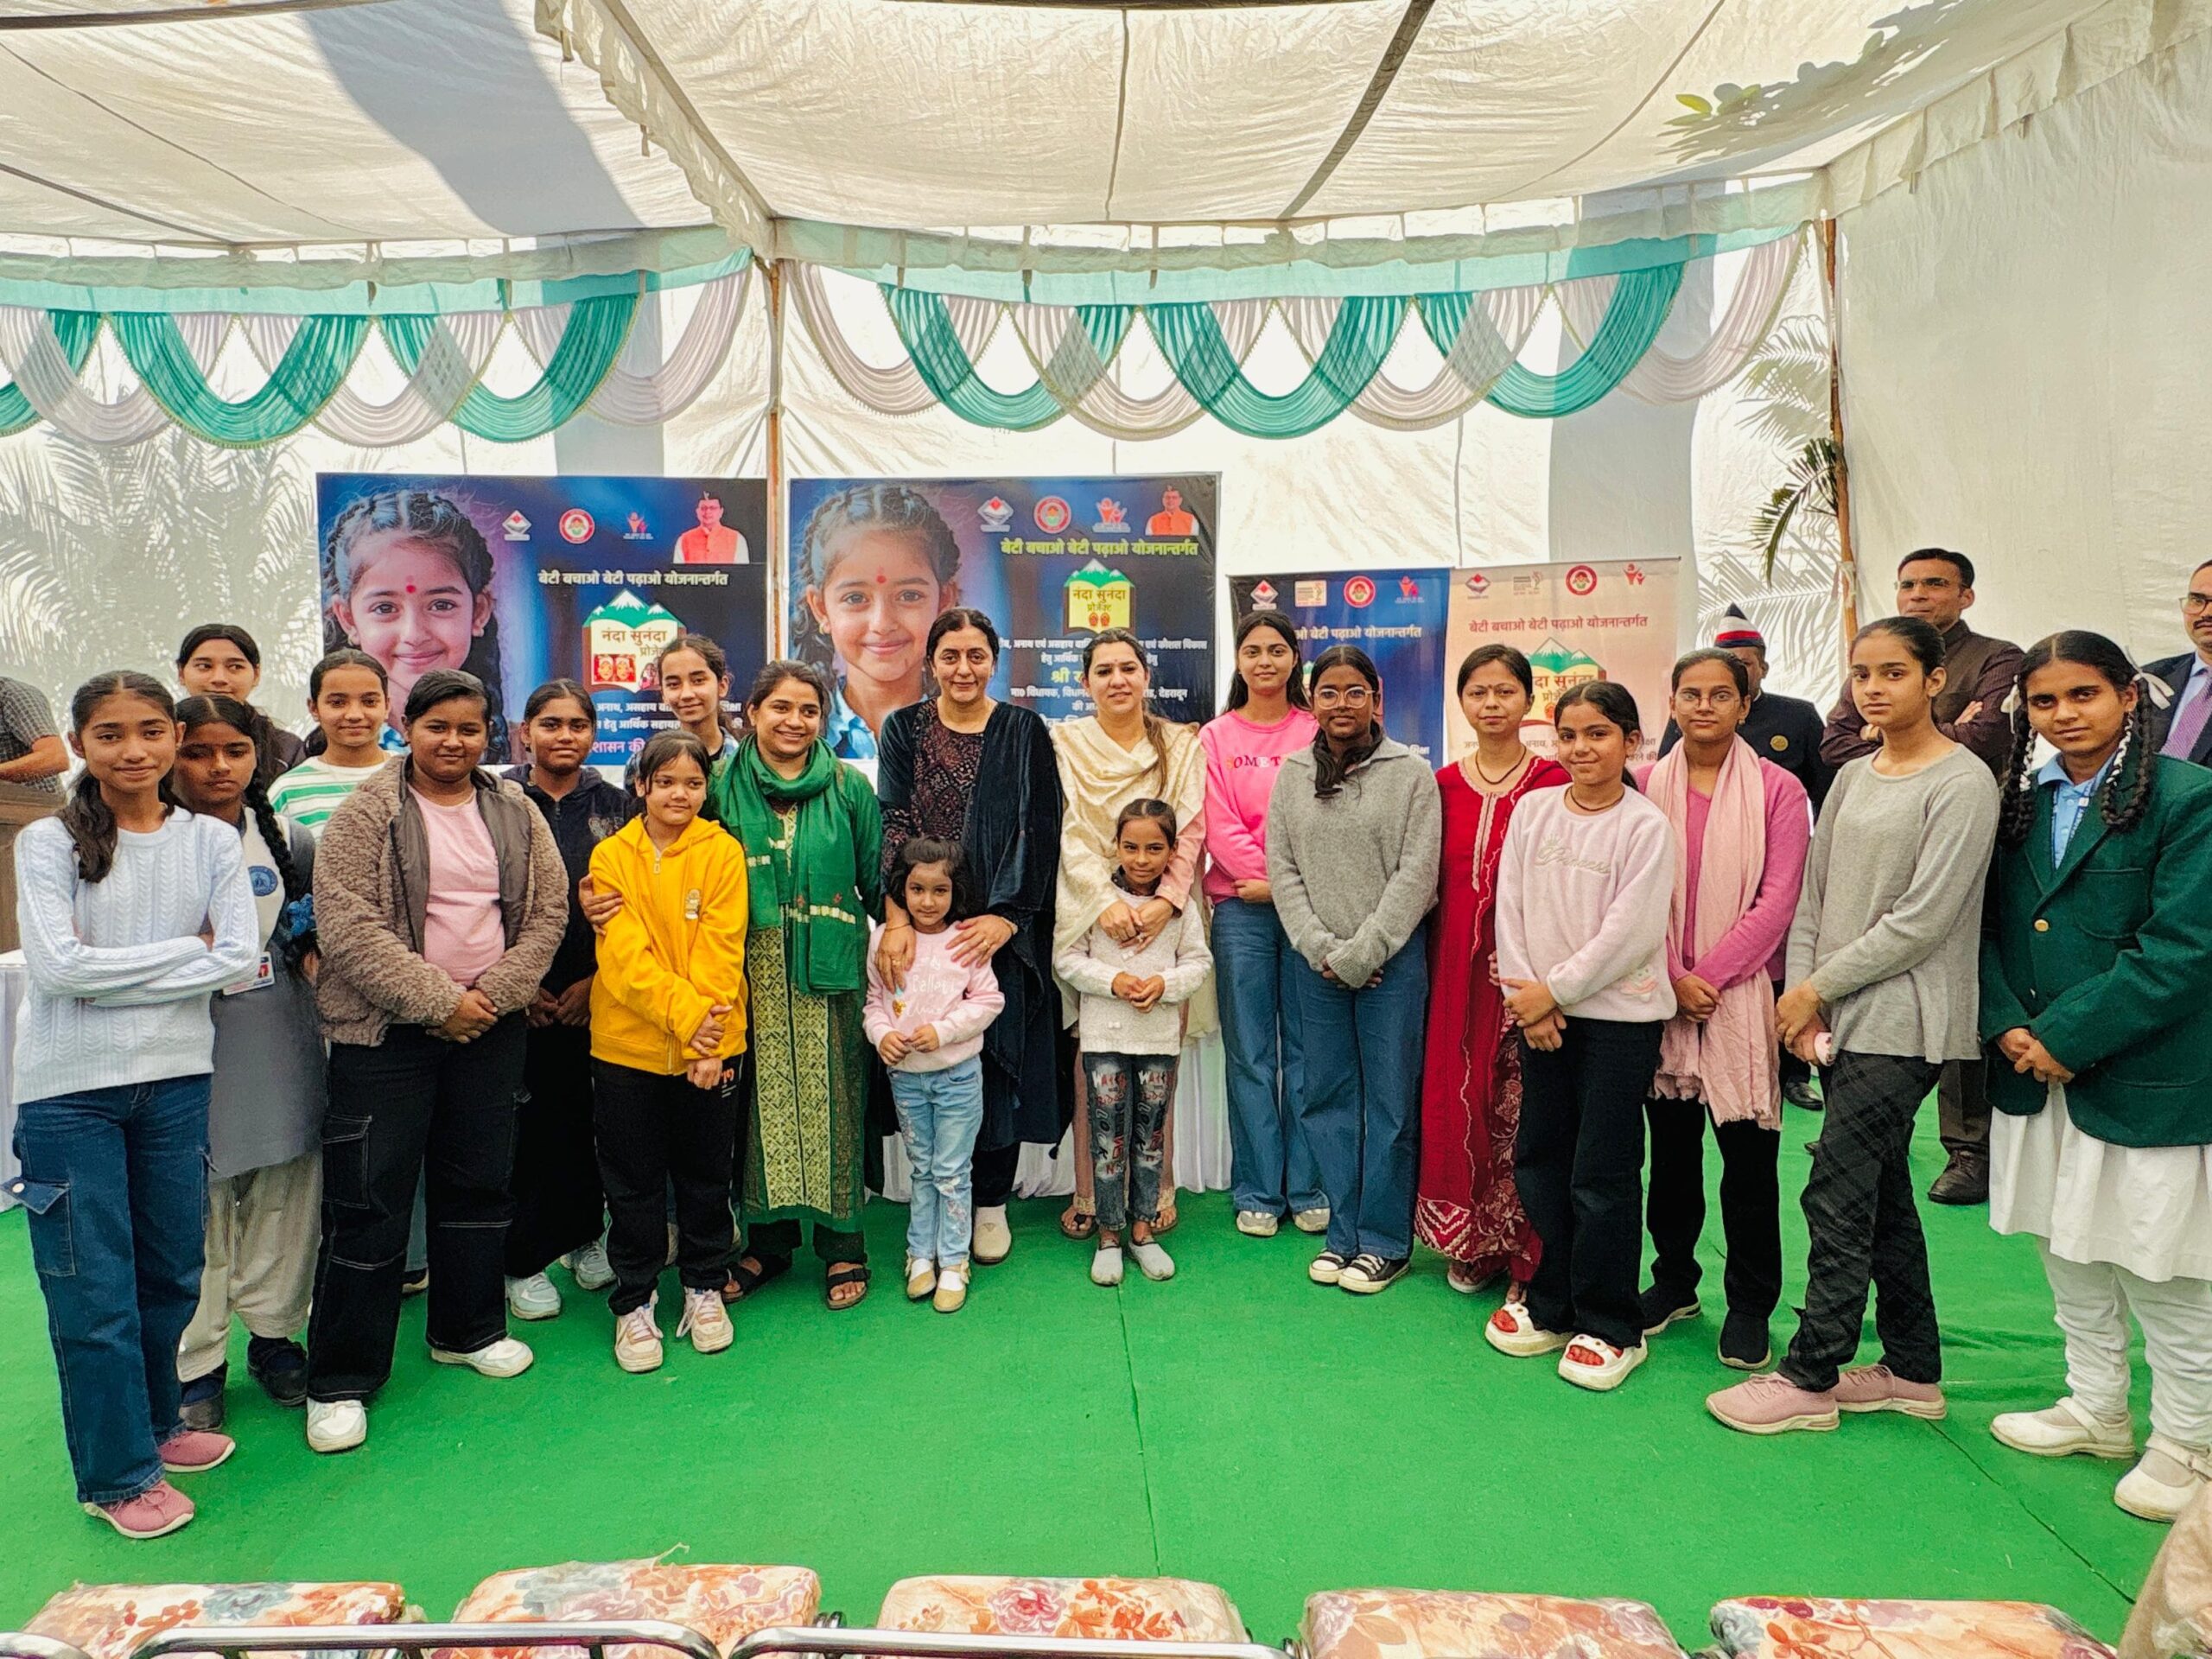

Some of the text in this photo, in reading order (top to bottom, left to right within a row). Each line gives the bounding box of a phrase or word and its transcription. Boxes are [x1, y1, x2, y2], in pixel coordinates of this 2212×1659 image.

[1001, 537, 1199, 557] बेटी बचाओ बेटी पढ़ाओ योजनान्तर्गत
[537, 569, 729, 587] बेटी बचाओ बेटी पढ़ाओ योजनान्तर्गत
[1072, 587, 1127, 603] नंदा सुनंदा
[1469, 613, 1649, 632] बेटी बचाओ बेटी पढ़ाओ योजनान्तर्गत
[602, 627, 667, 645] नंदा सुनंदा
[1310, 625, 1329, 640] बेटी
[1331, 625, 1361, 641] पढ़ाओ
[1363, 623, 1422, 639] योजनान्तर्गत
[1225, 754, 1282, 770] SOMET
